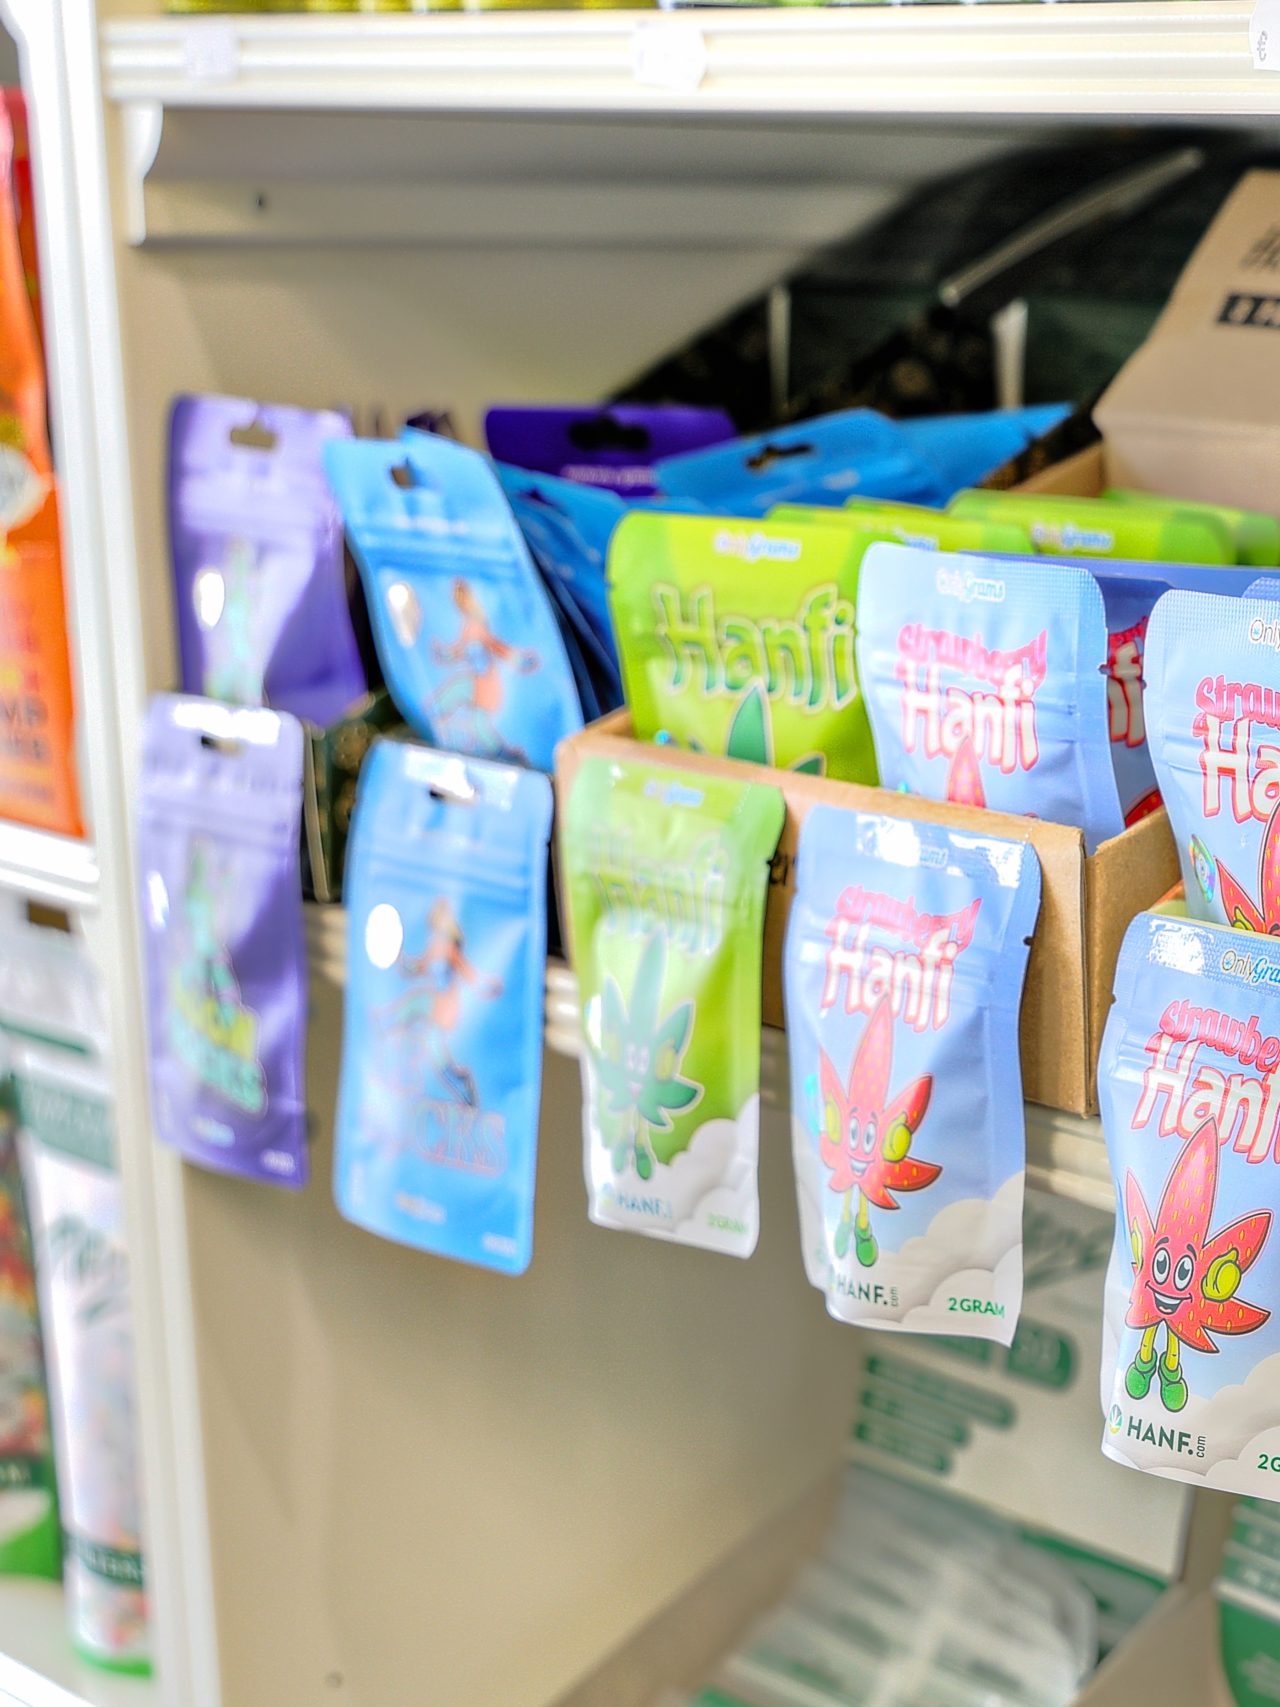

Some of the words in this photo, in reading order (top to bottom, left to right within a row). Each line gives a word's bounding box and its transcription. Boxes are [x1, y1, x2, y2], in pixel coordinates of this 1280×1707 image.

[1256, 30, 1268, 61] €
[651, 582, 860, 714] Hanfi
[896, 662, 1041, 774] Hanfi
[820, 917, 957, 1034] Hanfi
